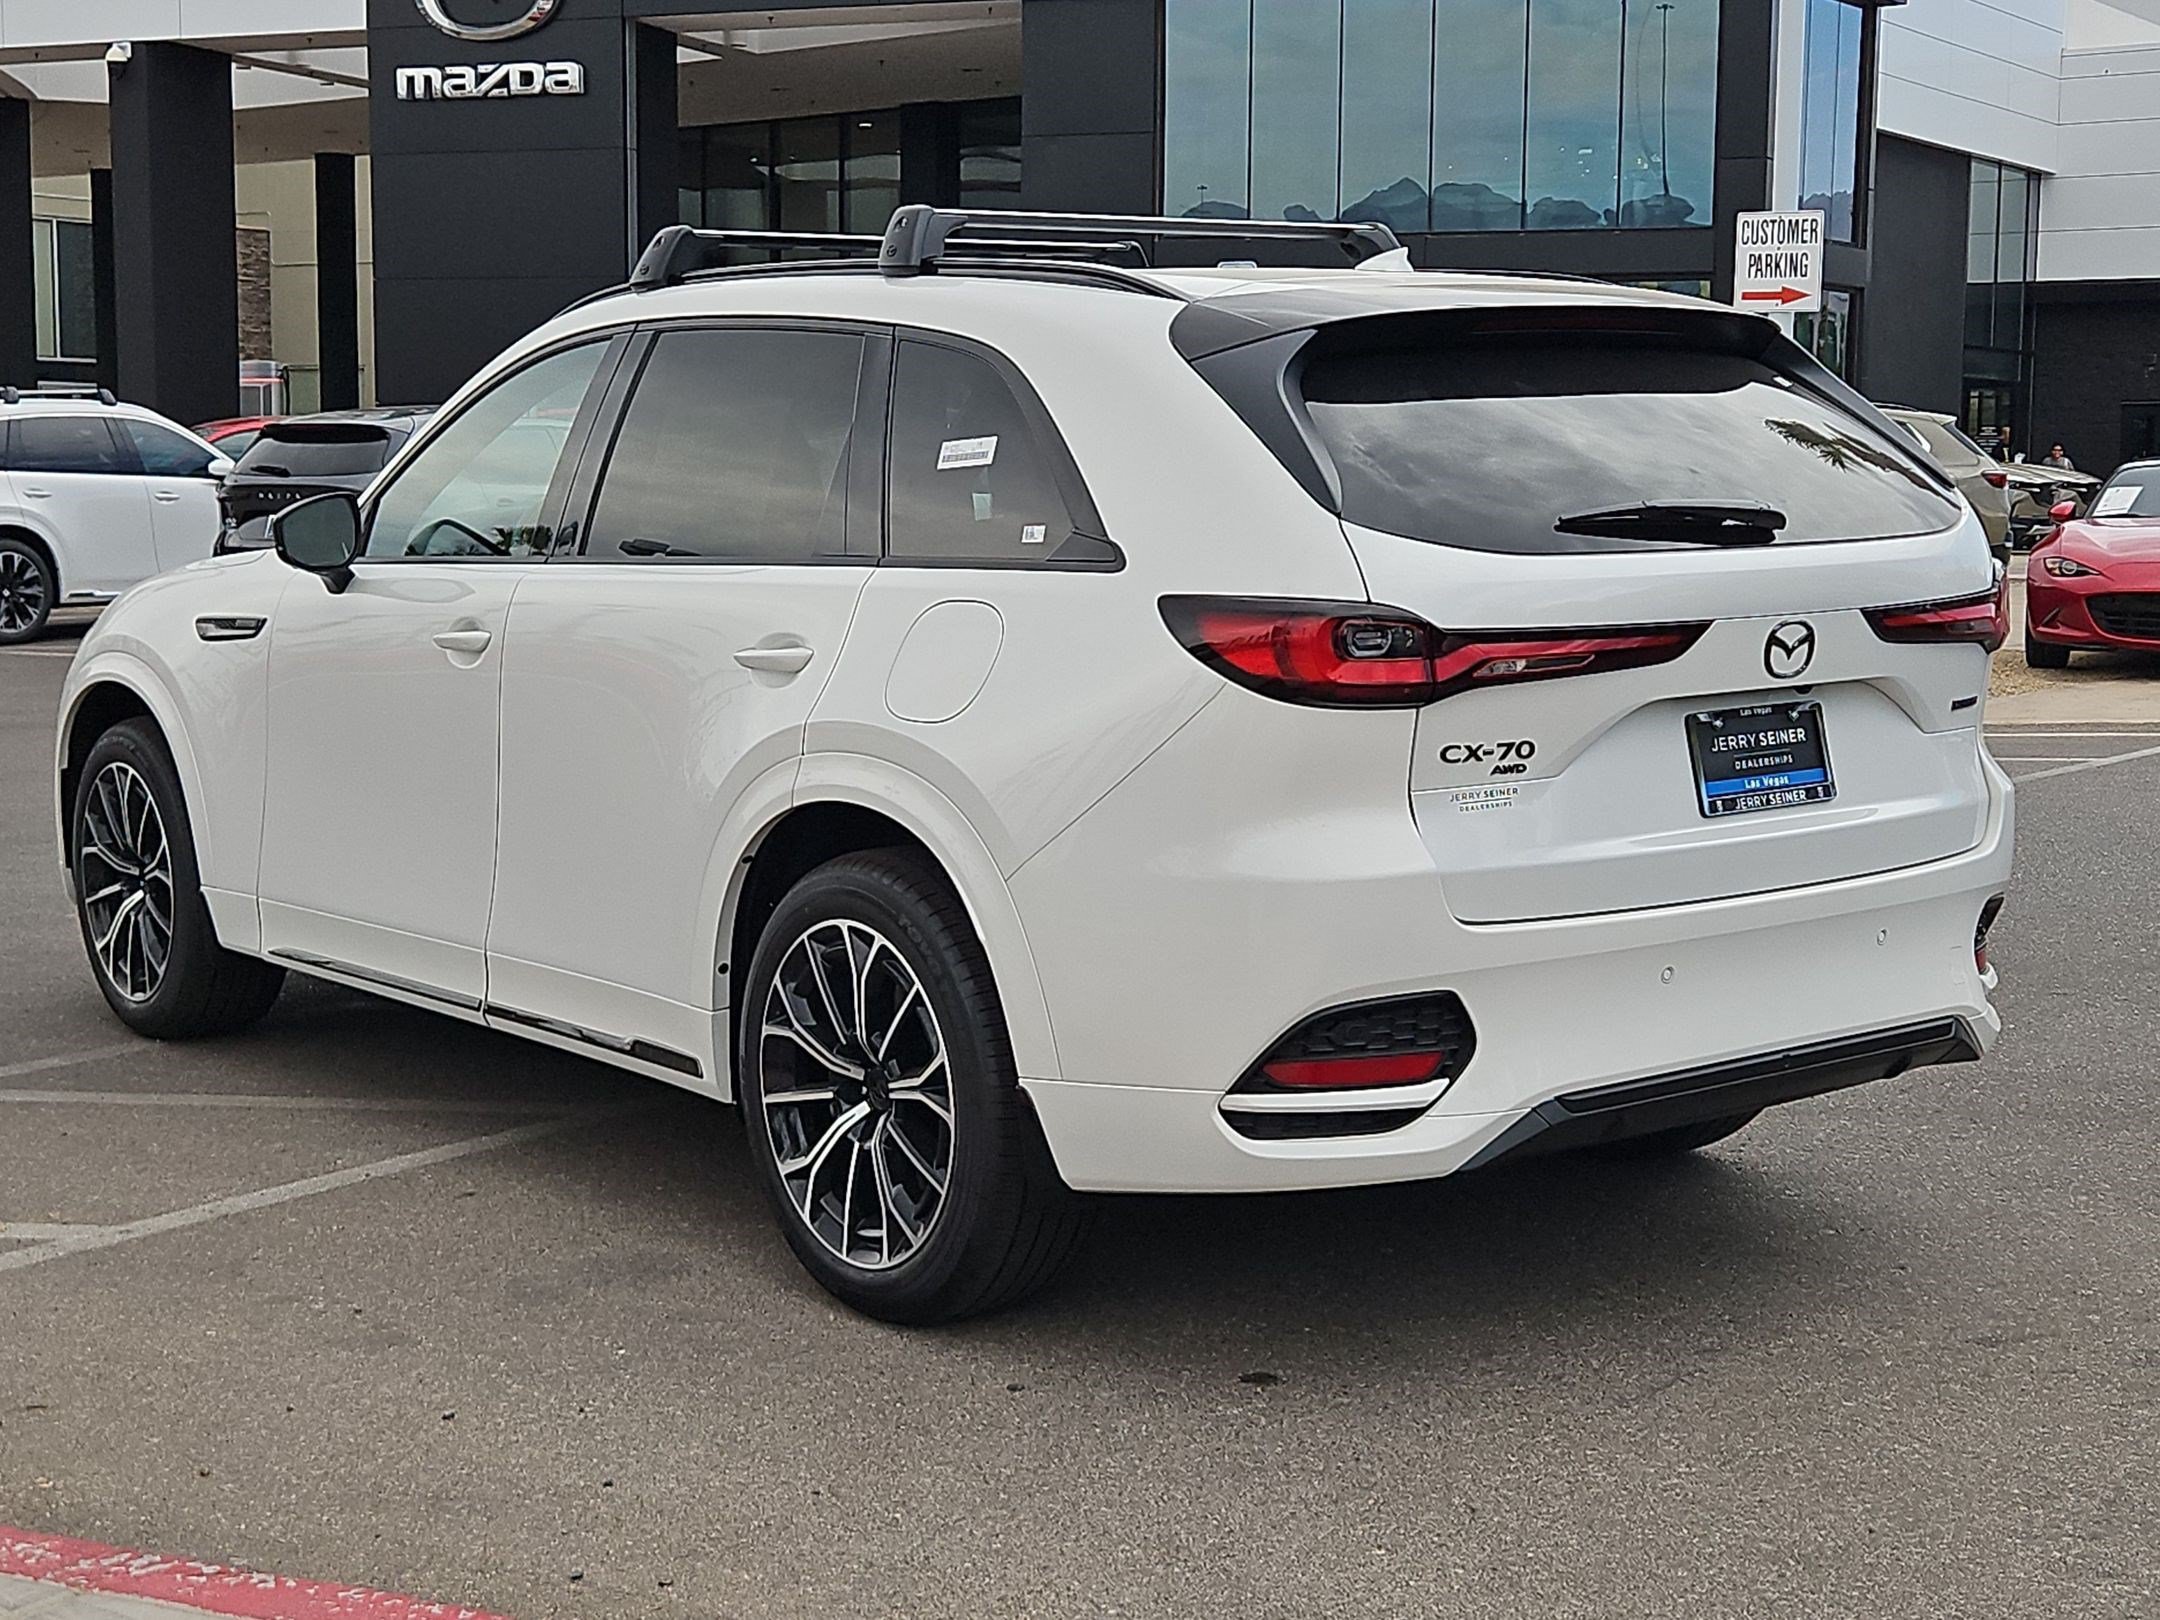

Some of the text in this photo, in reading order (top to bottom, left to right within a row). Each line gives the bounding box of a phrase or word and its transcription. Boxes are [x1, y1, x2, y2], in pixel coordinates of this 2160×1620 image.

[396, 62, 584, 99] mazda
[1741, 218, 1819, 245] CUSTOMER
[1748, 252, 1809, 278] PARKING
[1739, 708, 1752, 717] Las
[1711, 727, 1807, 752] JERRY SEINER
[1440, 740, 1536, 764] CX-70
[1490, 763, 1527, 776] AWD
[1734, 754, 1793, 770] DEALERSHIPS
[1744, 775, 1789, 789] Las Vegas
[1450, 788, 1519, 802] JERRY SEINER
[1735, 789, 1807, 810] JERRY SEINER
[1459, 801, 1512, 812] DEALERSHIPS
